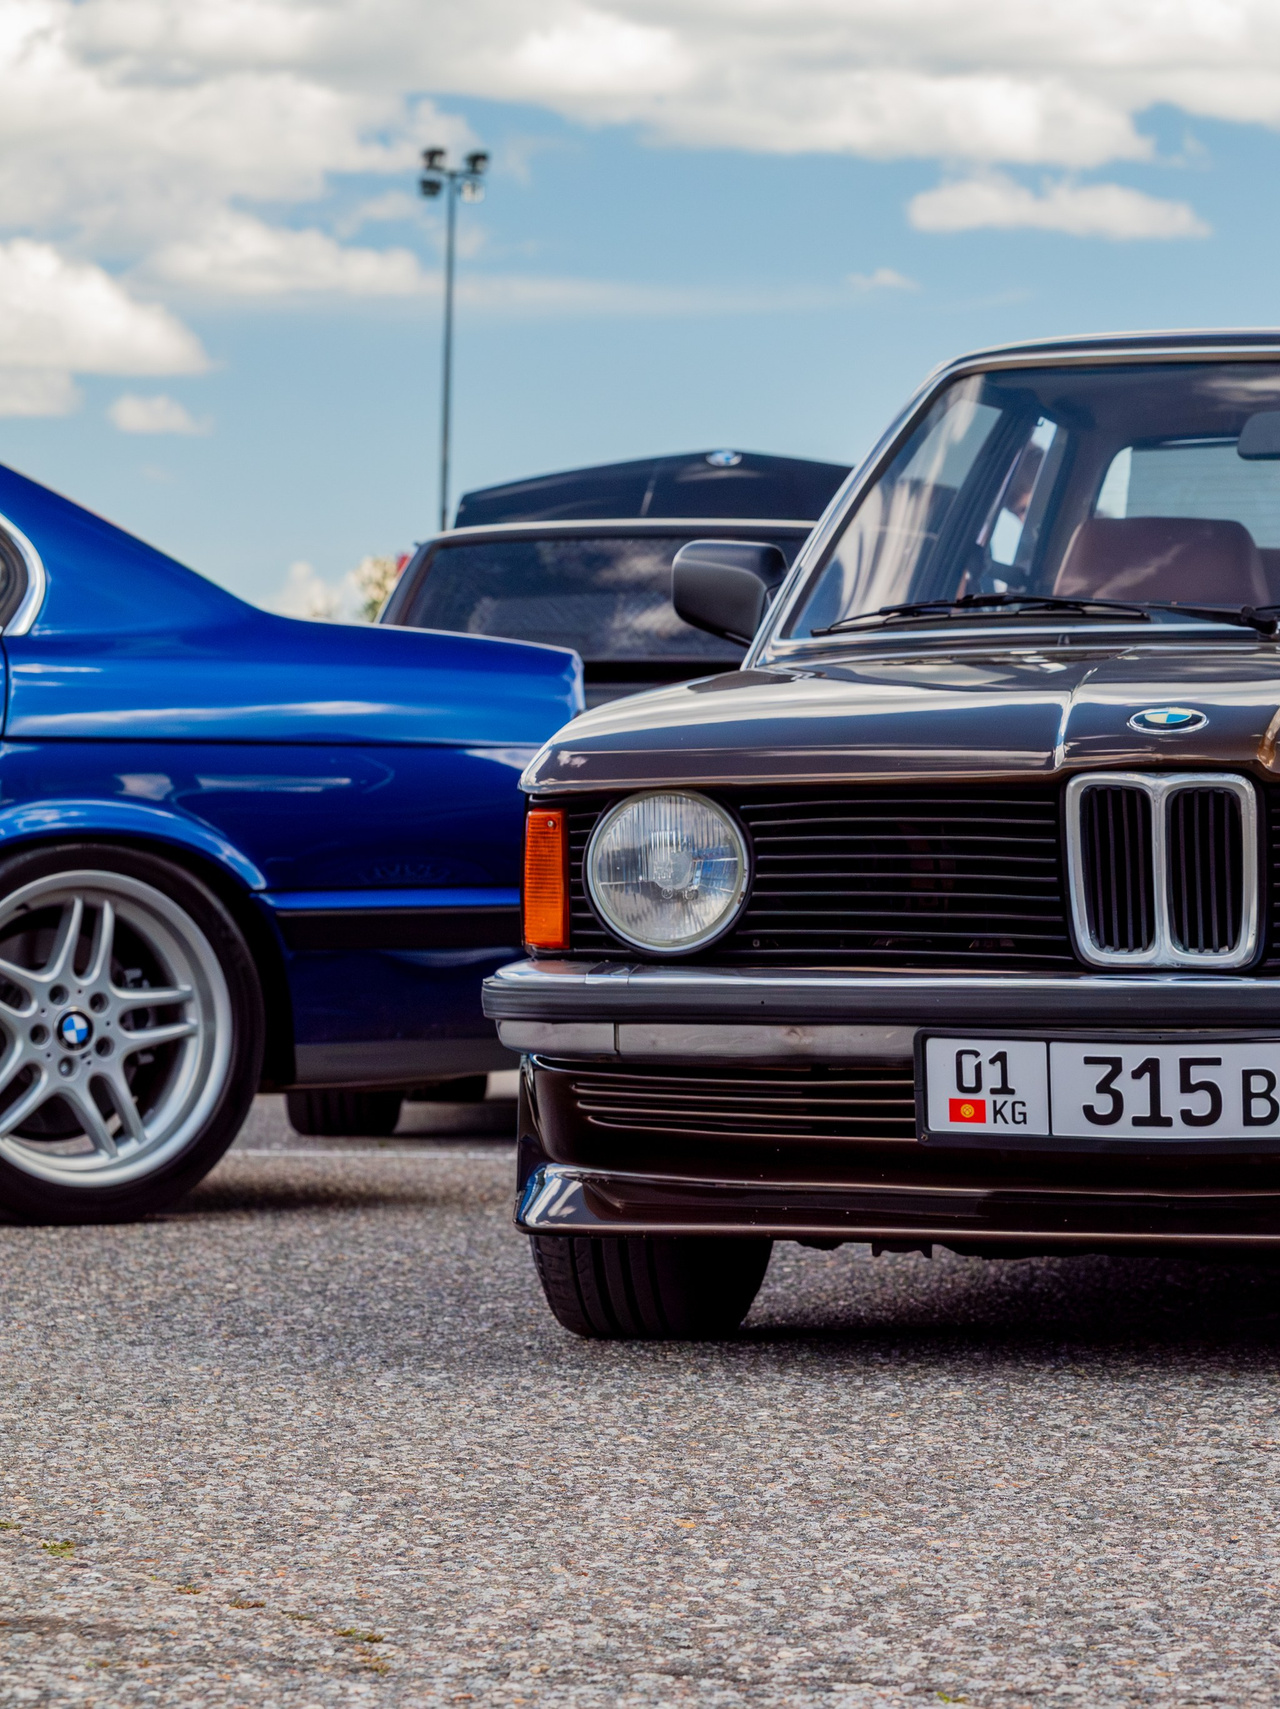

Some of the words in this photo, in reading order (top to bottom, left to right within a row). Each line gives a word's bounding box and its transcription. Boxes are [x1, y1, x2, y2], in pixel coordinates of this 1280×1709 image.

[955, 1049, 1016, 1095] 01
[1082, 1056, 1223, 1127] 315
[992, 1099, 1028, 1125] KG
